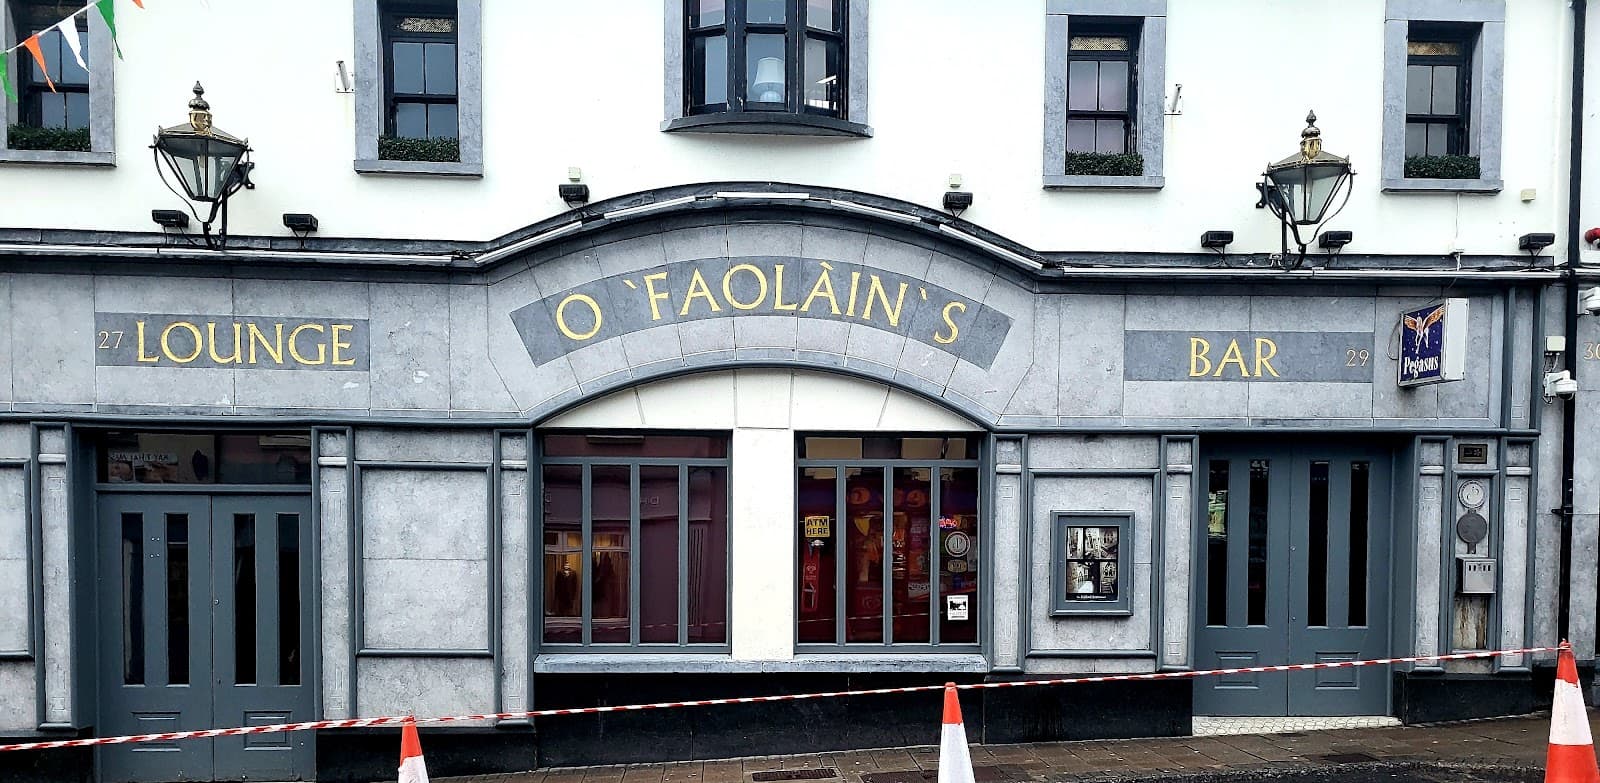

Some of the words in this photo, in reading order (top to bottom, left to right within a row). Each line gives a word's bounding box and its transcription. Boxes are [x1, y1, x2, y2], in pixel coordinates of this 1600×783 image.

[556, 294, 602, 341] O
[98, 330, 124, 349] 27
[136, 320, 356, 365] LOUNGE
[1189, 337, 1280, 378] BAR
[1345, 348, 1370, 368] 29
[1403, 355, 1439, 377] Pegasus
[806, 527, 829, 535] HERE
[807, 518, 828, 526] ATM
